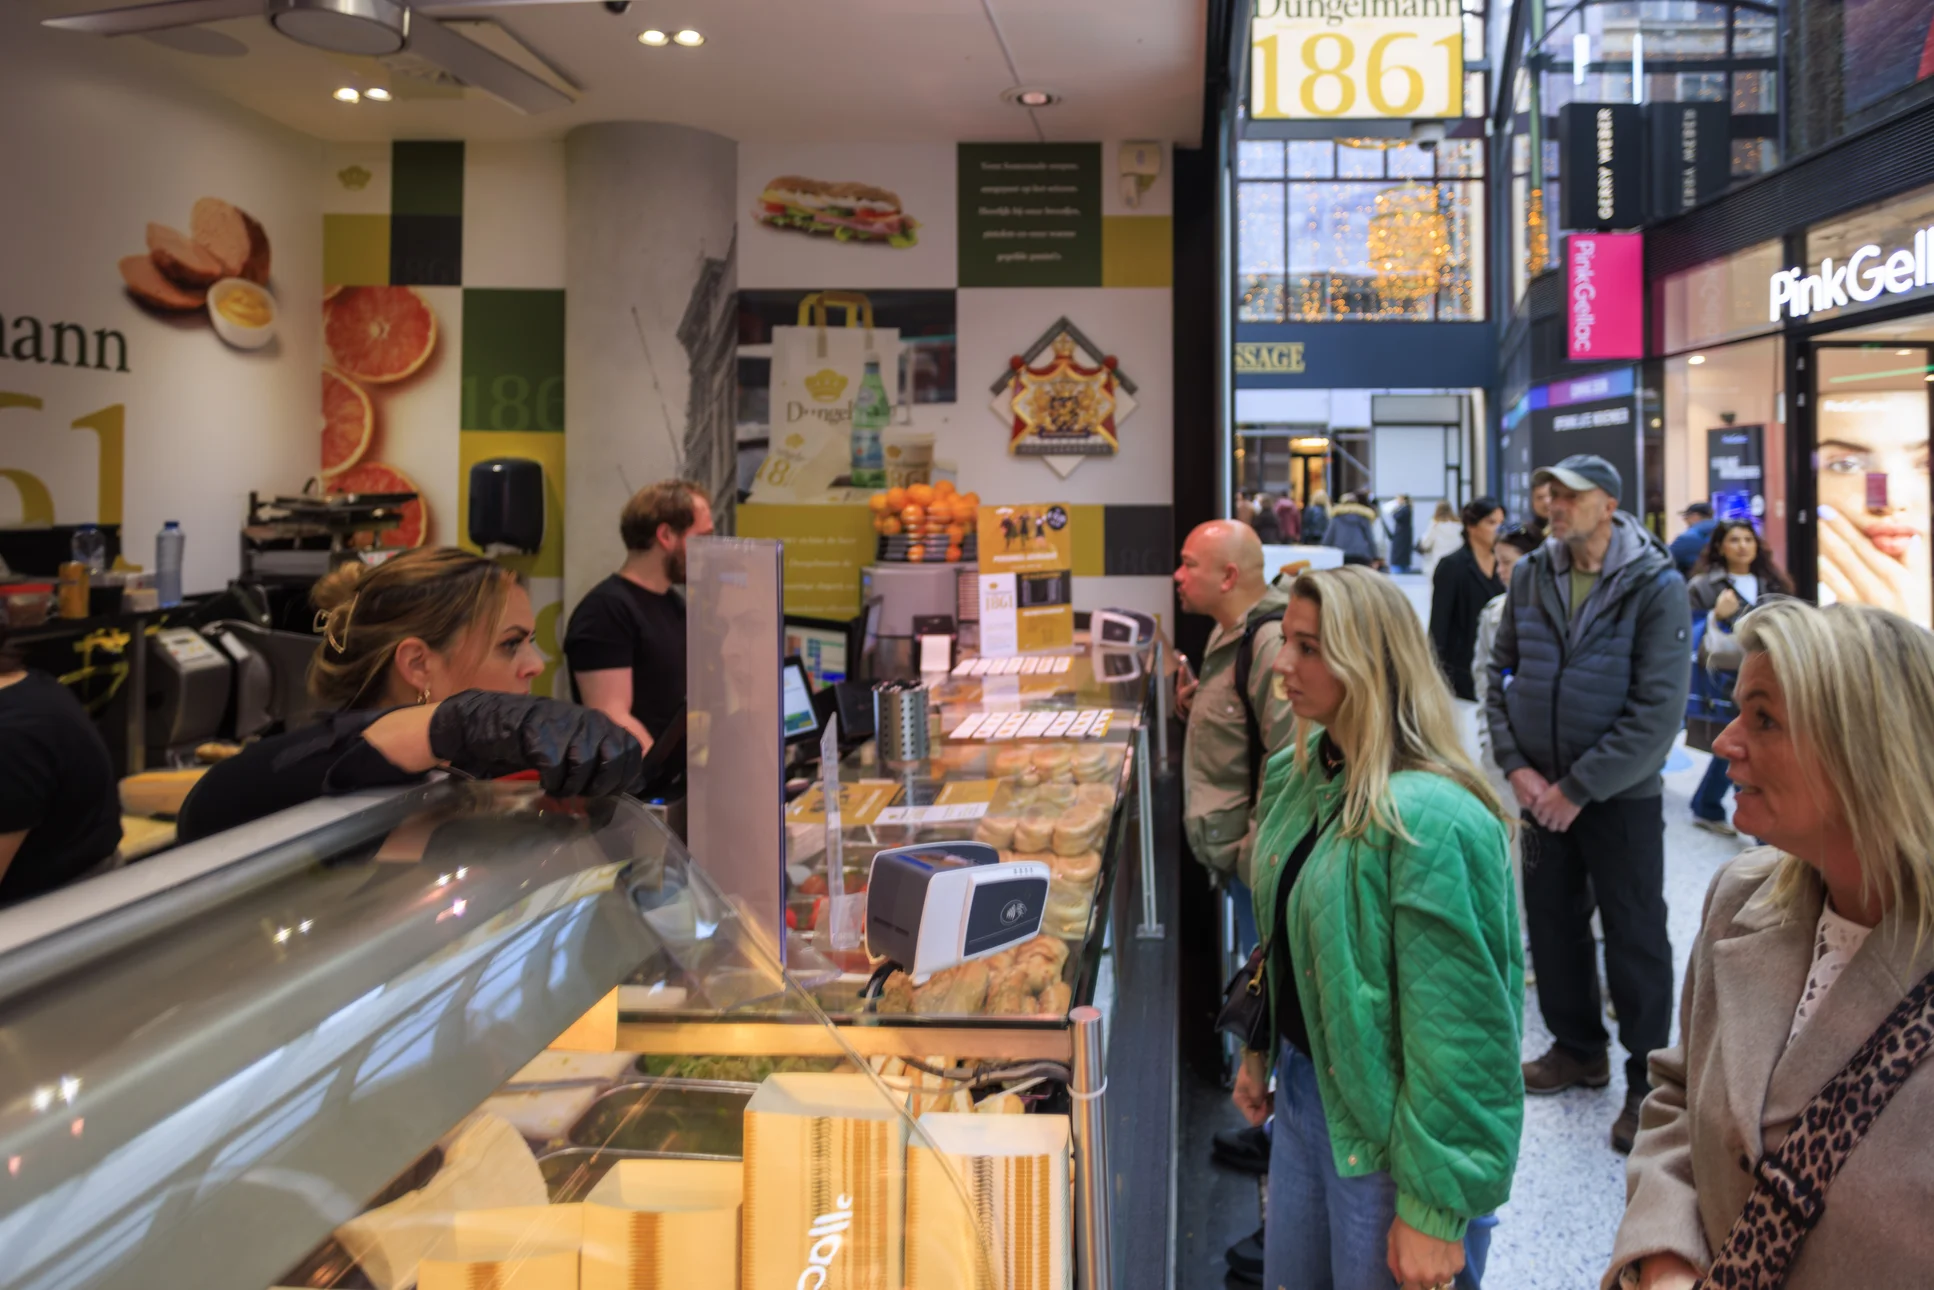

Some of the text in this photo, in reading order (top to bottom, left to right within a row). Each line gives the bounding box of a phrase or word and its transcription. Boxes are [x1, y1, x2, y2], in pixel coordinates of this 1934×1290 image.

[1253, 32, 1462, 119] 1861
[1597, 108, 1614, 220] GERRY WEBER
[1573, 240, 1596, 352] PinkGellac
